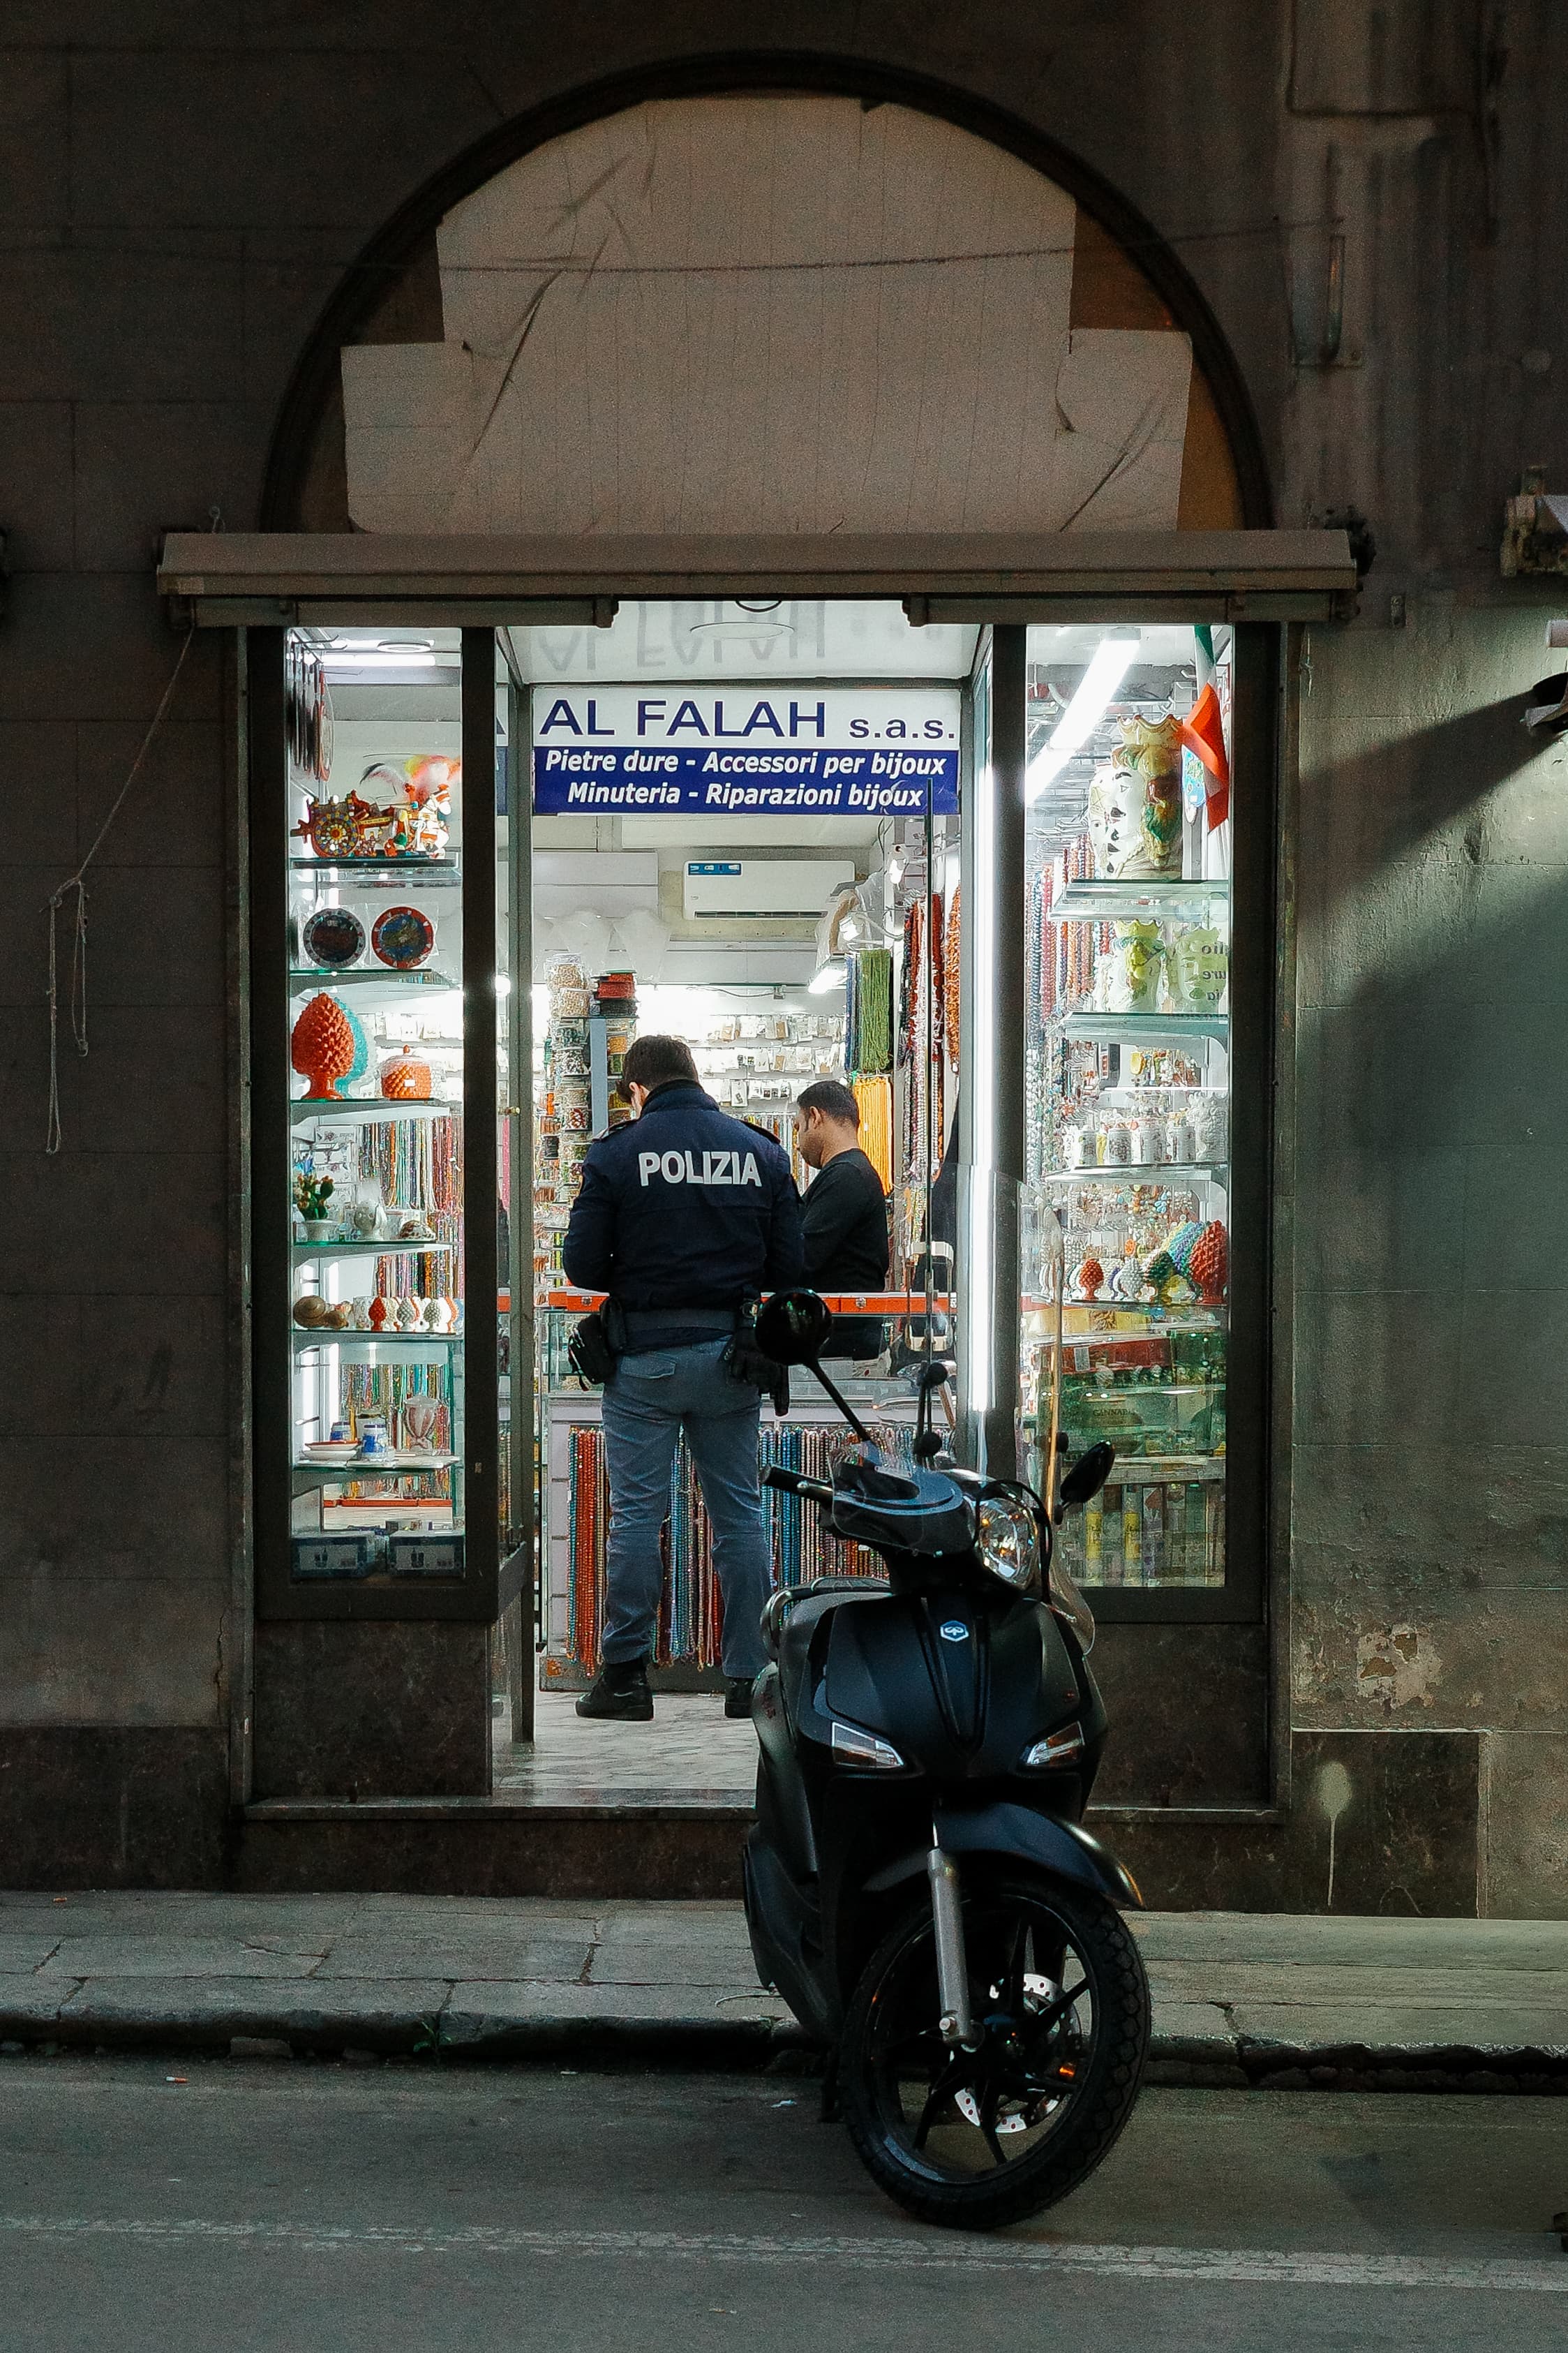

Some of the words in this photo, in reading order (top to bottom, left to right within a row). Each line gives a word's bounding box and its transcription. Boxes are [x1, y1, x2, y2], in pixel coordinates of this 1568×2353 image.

[539, 699, 615, 735] AL
[637, 700, 825, 737] FALAH
[849, 718, 955, 738] s.a.s.
[545, 749, 617, 771] Pietre
[623, 750, 679, 772] dure
[702, 751, 819, 773] Accessori
[823, 755, 865, 778] per
[871, 752, 946, 779] bijoux
[567, 781, 681, 804] Minuteria
[705, 782, 843, 810] Riparazioni
[848, 783, 923, 810] bijoux
[639, 1150, 762, 1187] POLIZIA
